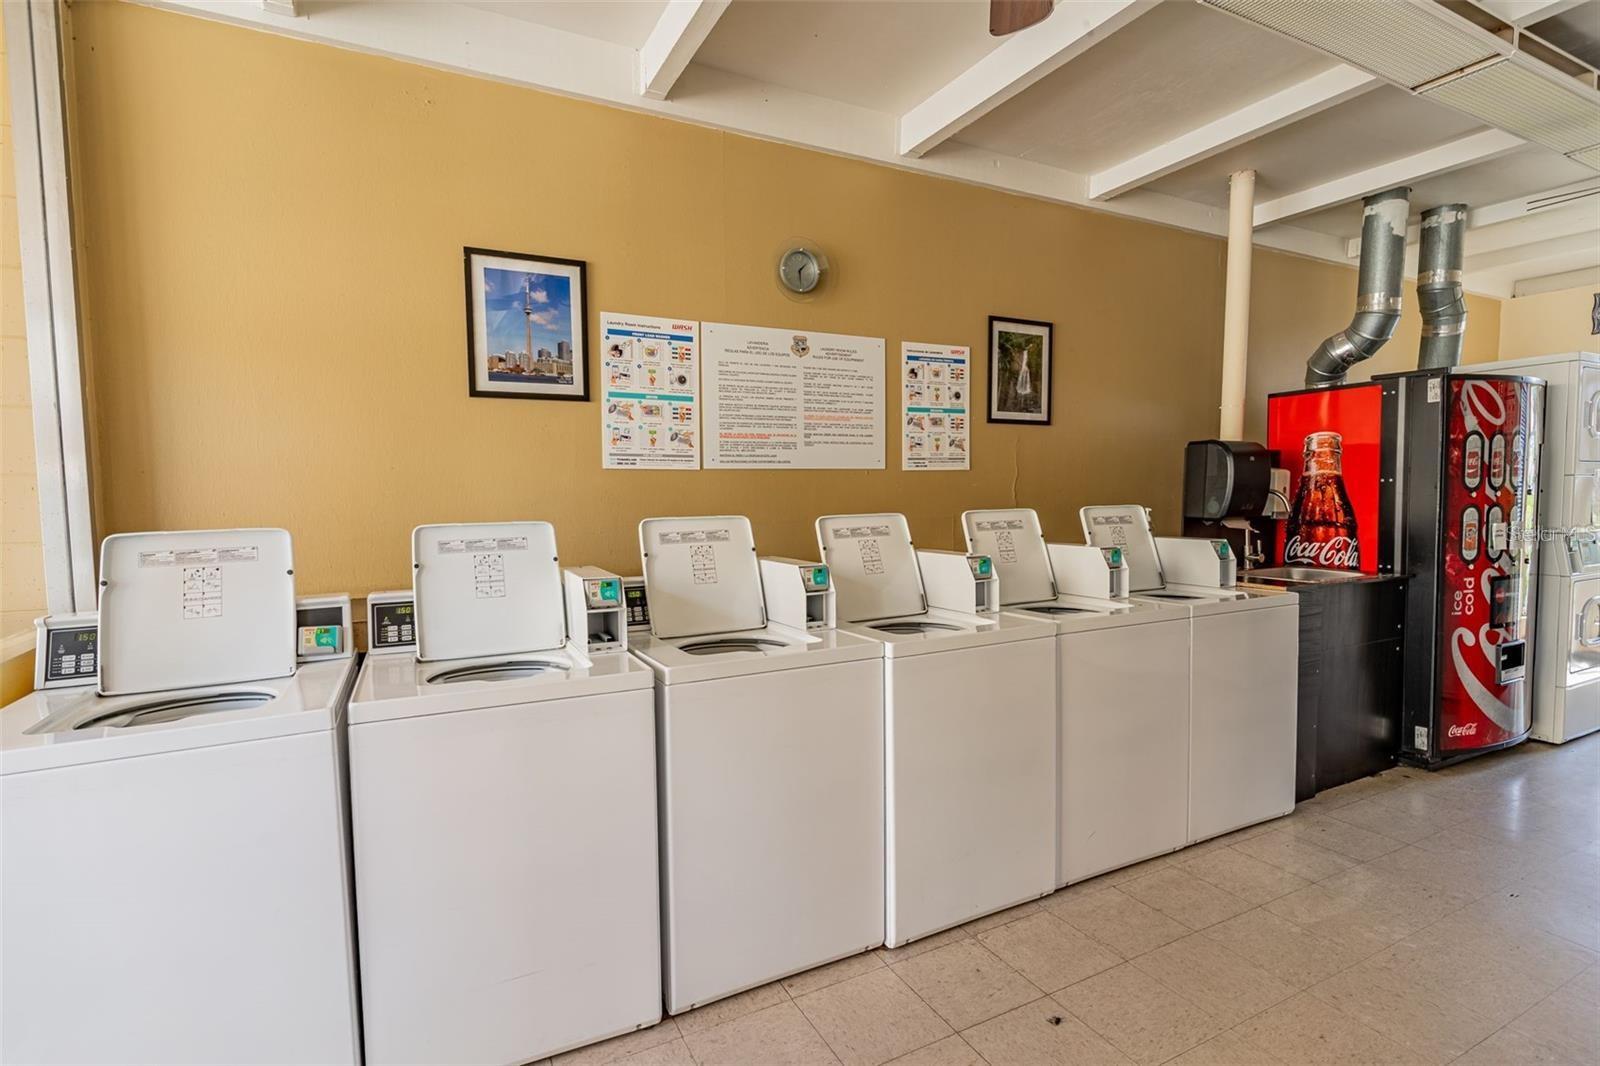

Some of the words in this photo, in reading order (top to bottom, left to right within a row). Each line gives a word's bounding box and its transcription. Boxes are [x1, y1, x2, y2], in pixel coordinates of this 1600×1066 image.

[671, 323, 693, 331] WASH
[1284, 535, 1359, 567] Coca-Cola
[1451, 590, 1463, 615] ice
[1463, 577, 1475, 615] cold
[1448, 722, 1478, 737] Coca-Cola
